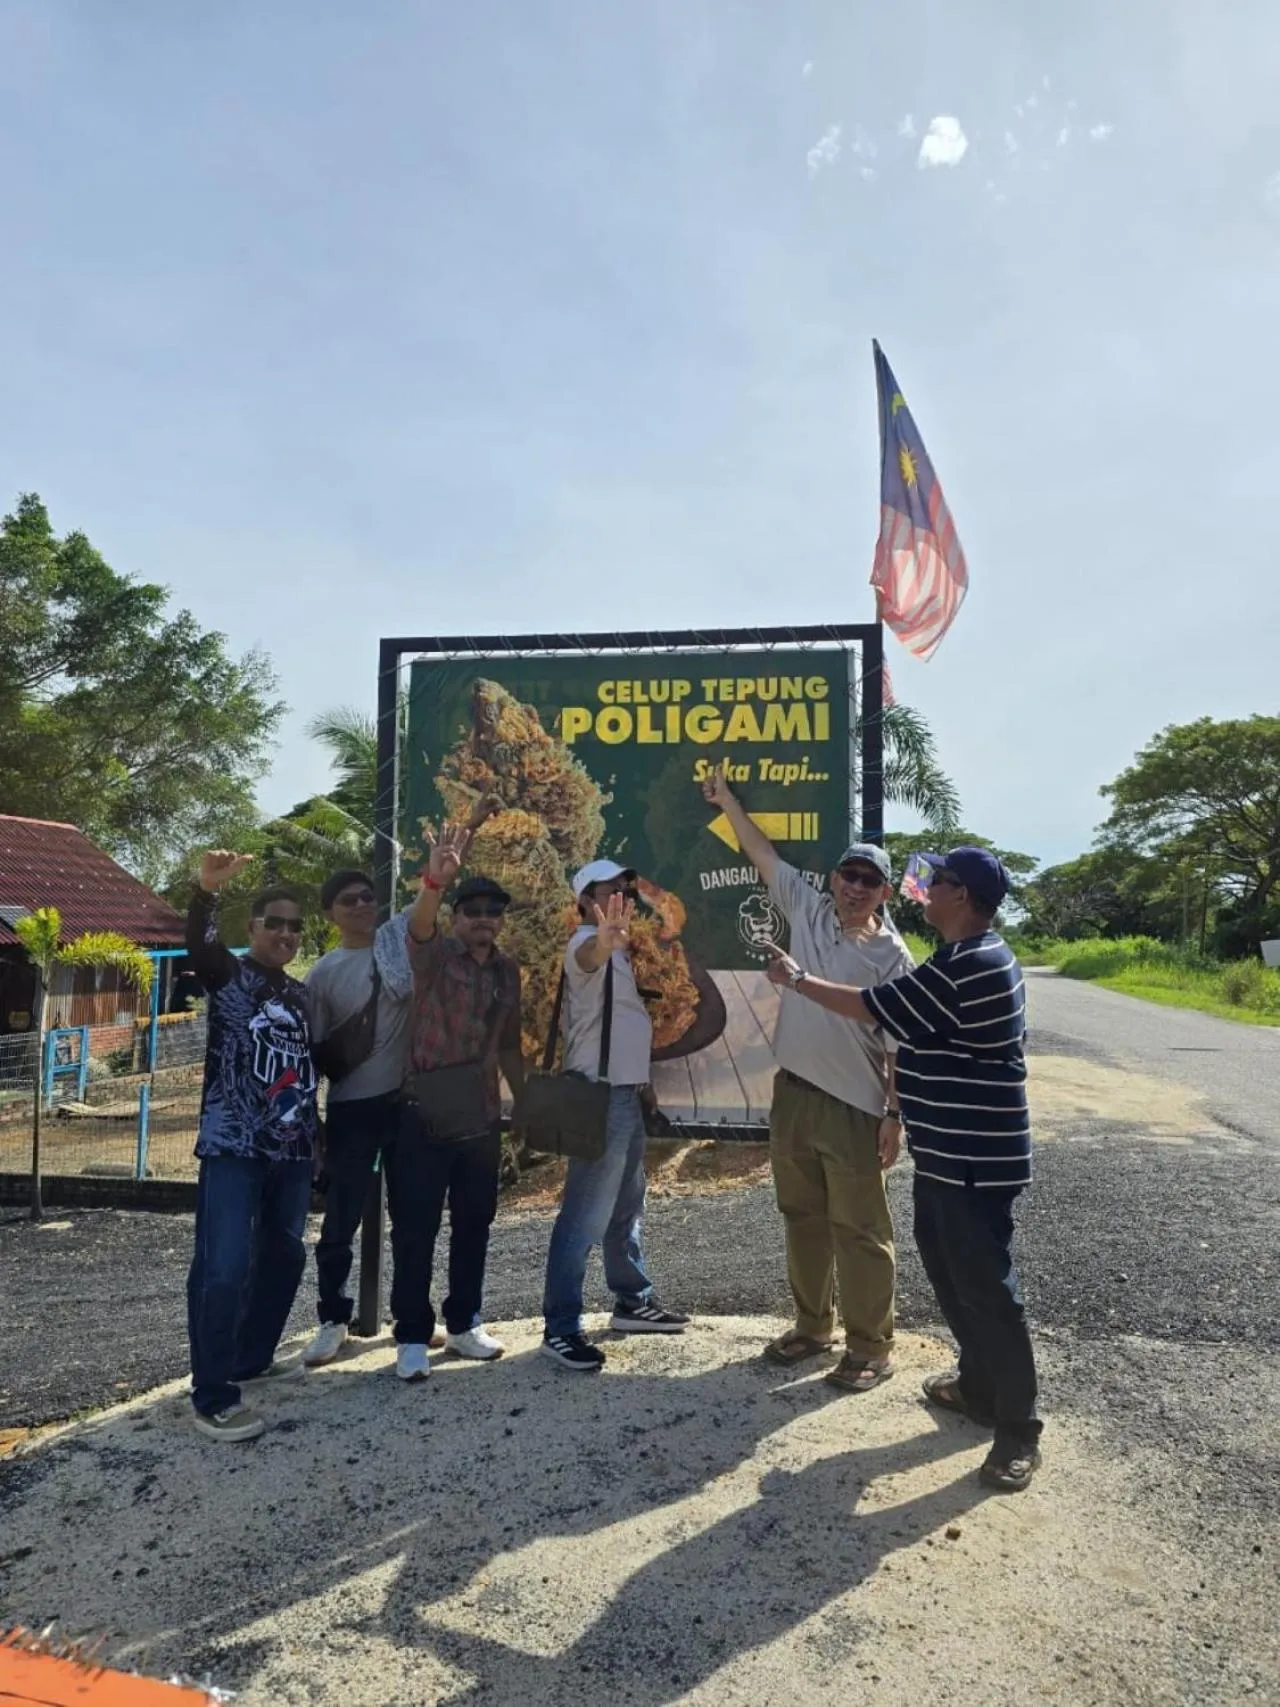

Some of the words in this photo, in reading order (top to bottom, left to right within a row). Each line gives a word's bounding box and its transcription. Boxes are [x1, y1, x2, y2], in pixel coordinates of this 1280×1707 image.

[597, 679, 691, 703] CELUP
[701, 676, 829, 701] TEPUNG
[562, 702, 830, 744] POLIGAMI
[758, 756, 829, 786] Tapi...
[700, 865, 759, 890] DANGAU
